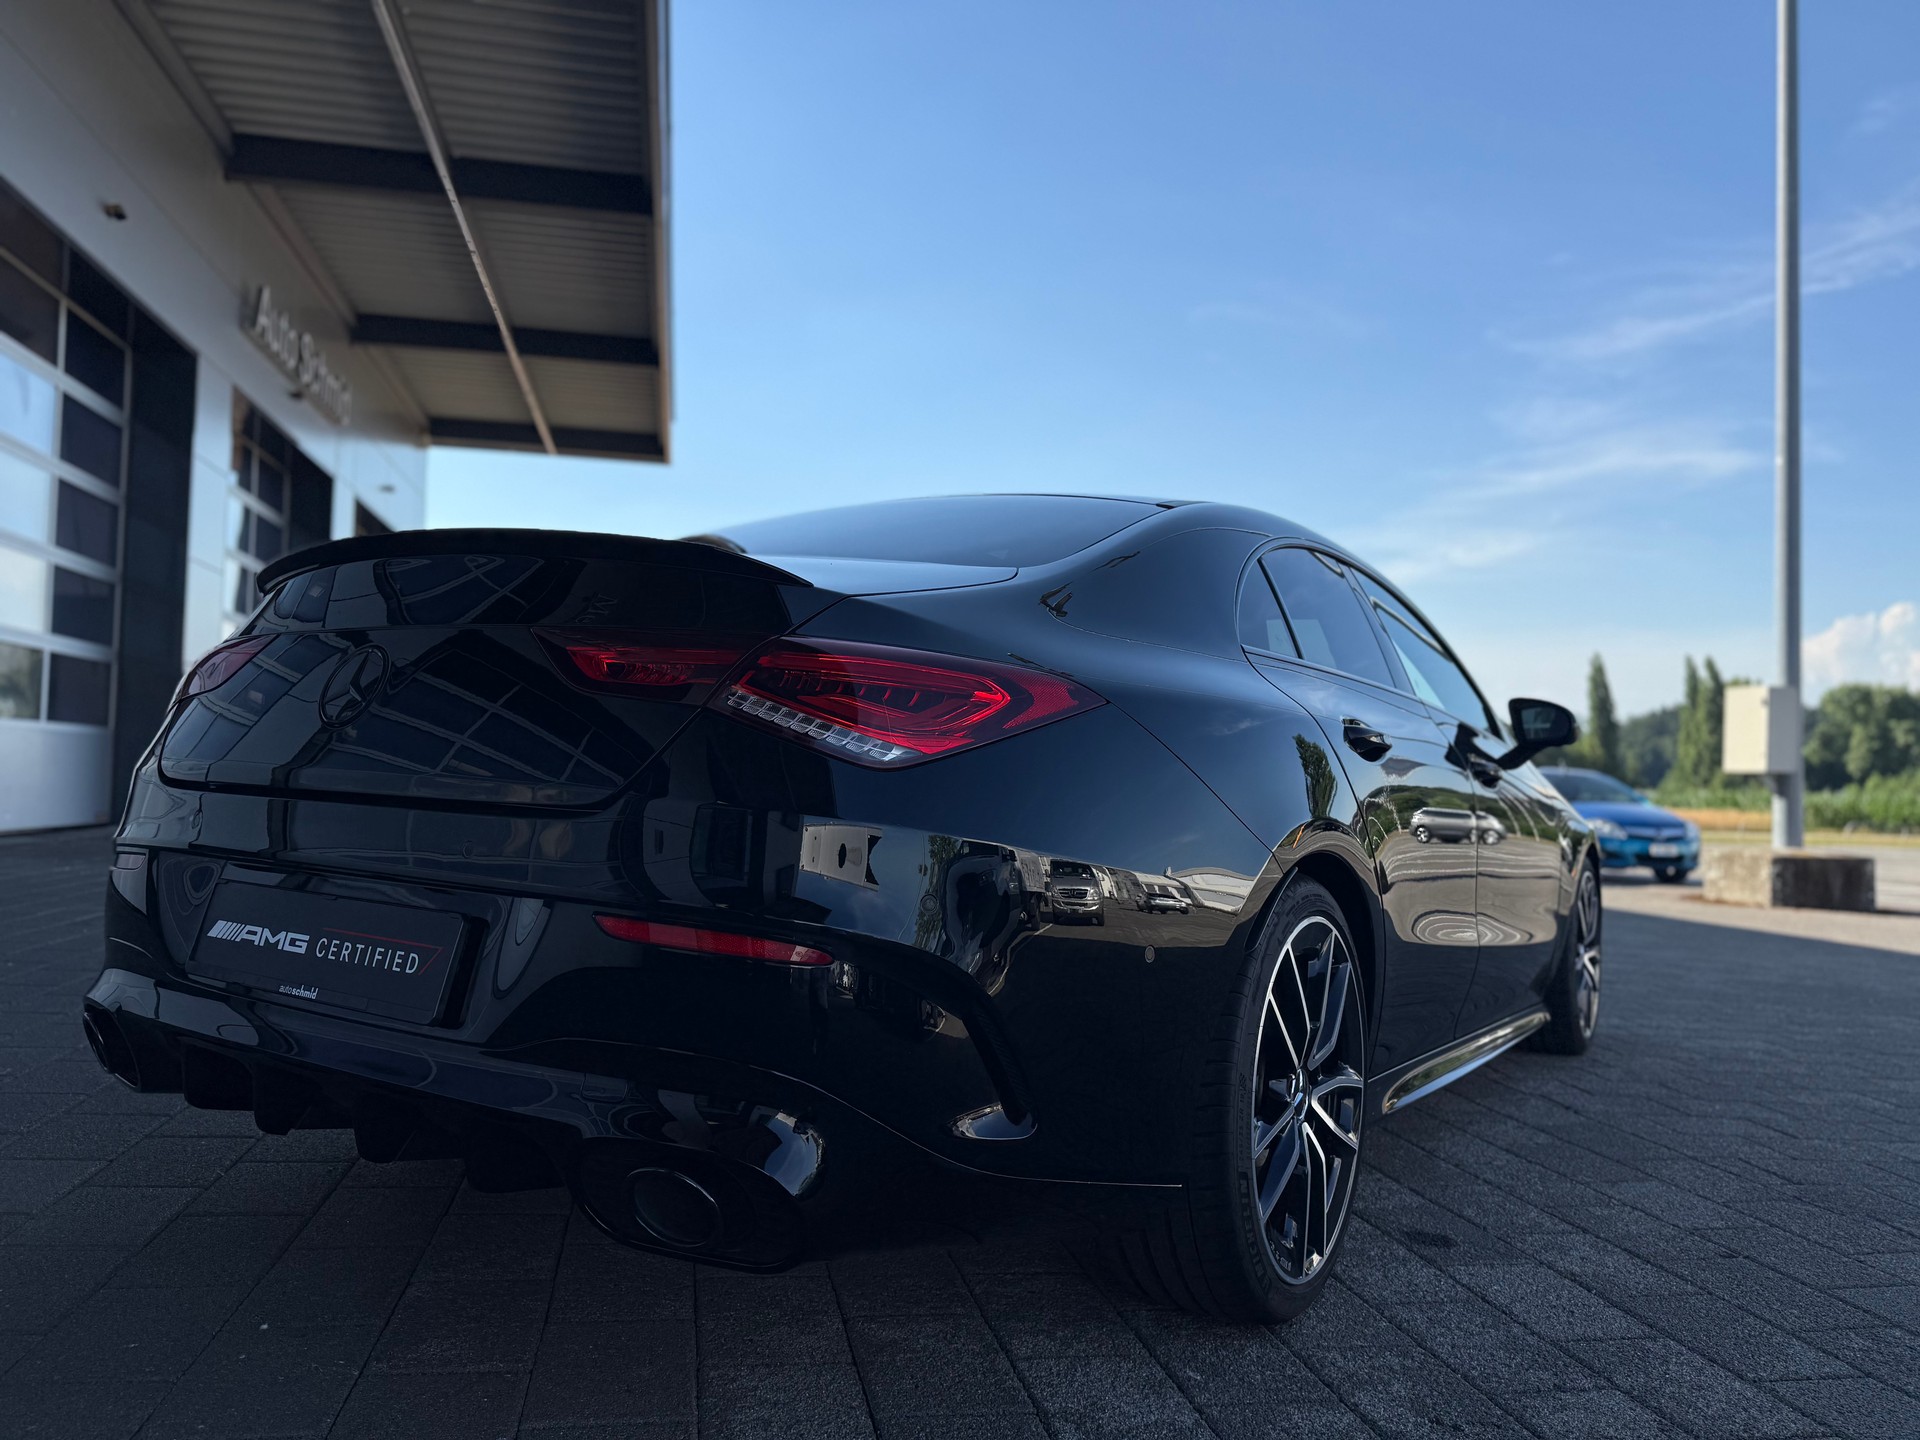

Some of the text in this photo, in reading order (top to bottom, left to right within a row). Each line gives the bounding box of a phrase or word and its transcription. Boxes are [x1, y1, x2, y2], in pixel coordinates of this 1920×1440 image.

[255, 285, 299, 370] Auto
[236, 924, 420, 975] AMG CERTIFIED
